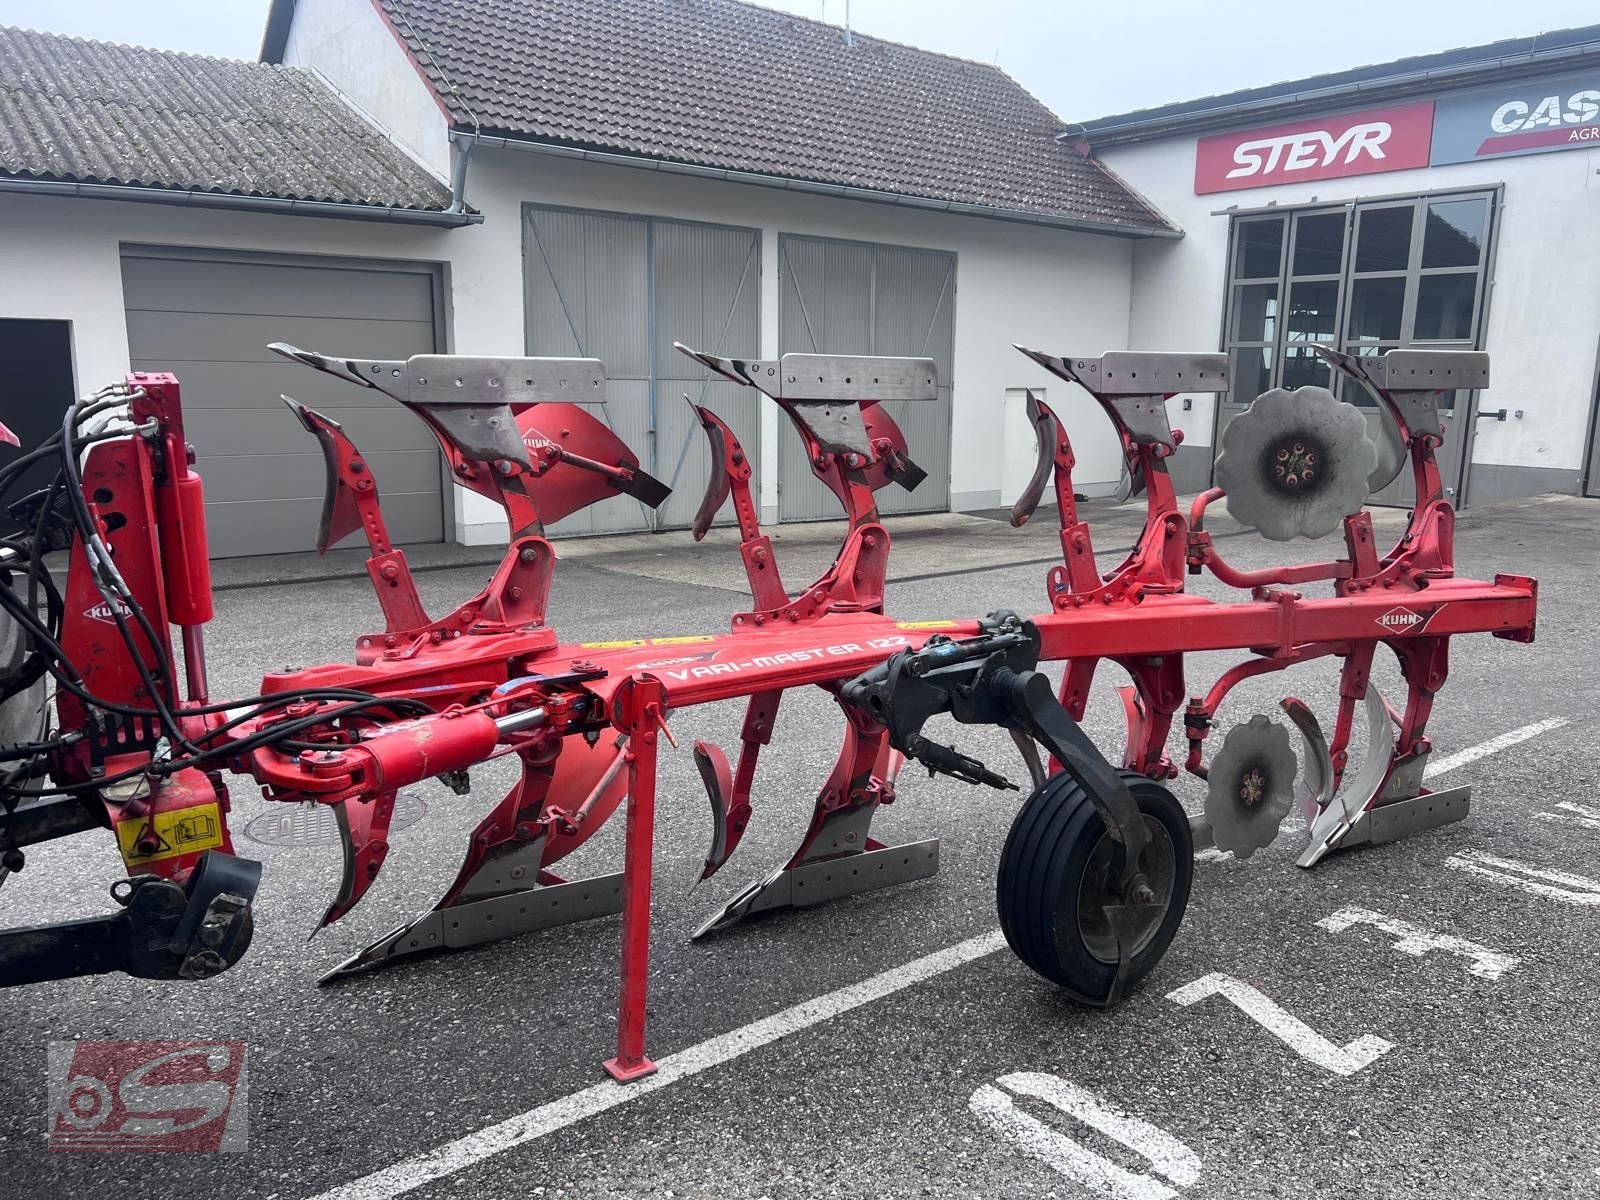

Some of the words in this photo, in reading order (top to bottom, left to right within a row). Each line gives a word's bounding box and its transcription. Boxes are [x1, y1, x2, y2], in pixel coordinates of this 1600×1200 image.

[1226, 122, 1392, 178] STEYR
[1382, 614, 1417, 625] KUHN
[667, 643, 865, 680] VARI-MASTER
[866, 636, 911, 649] 122
